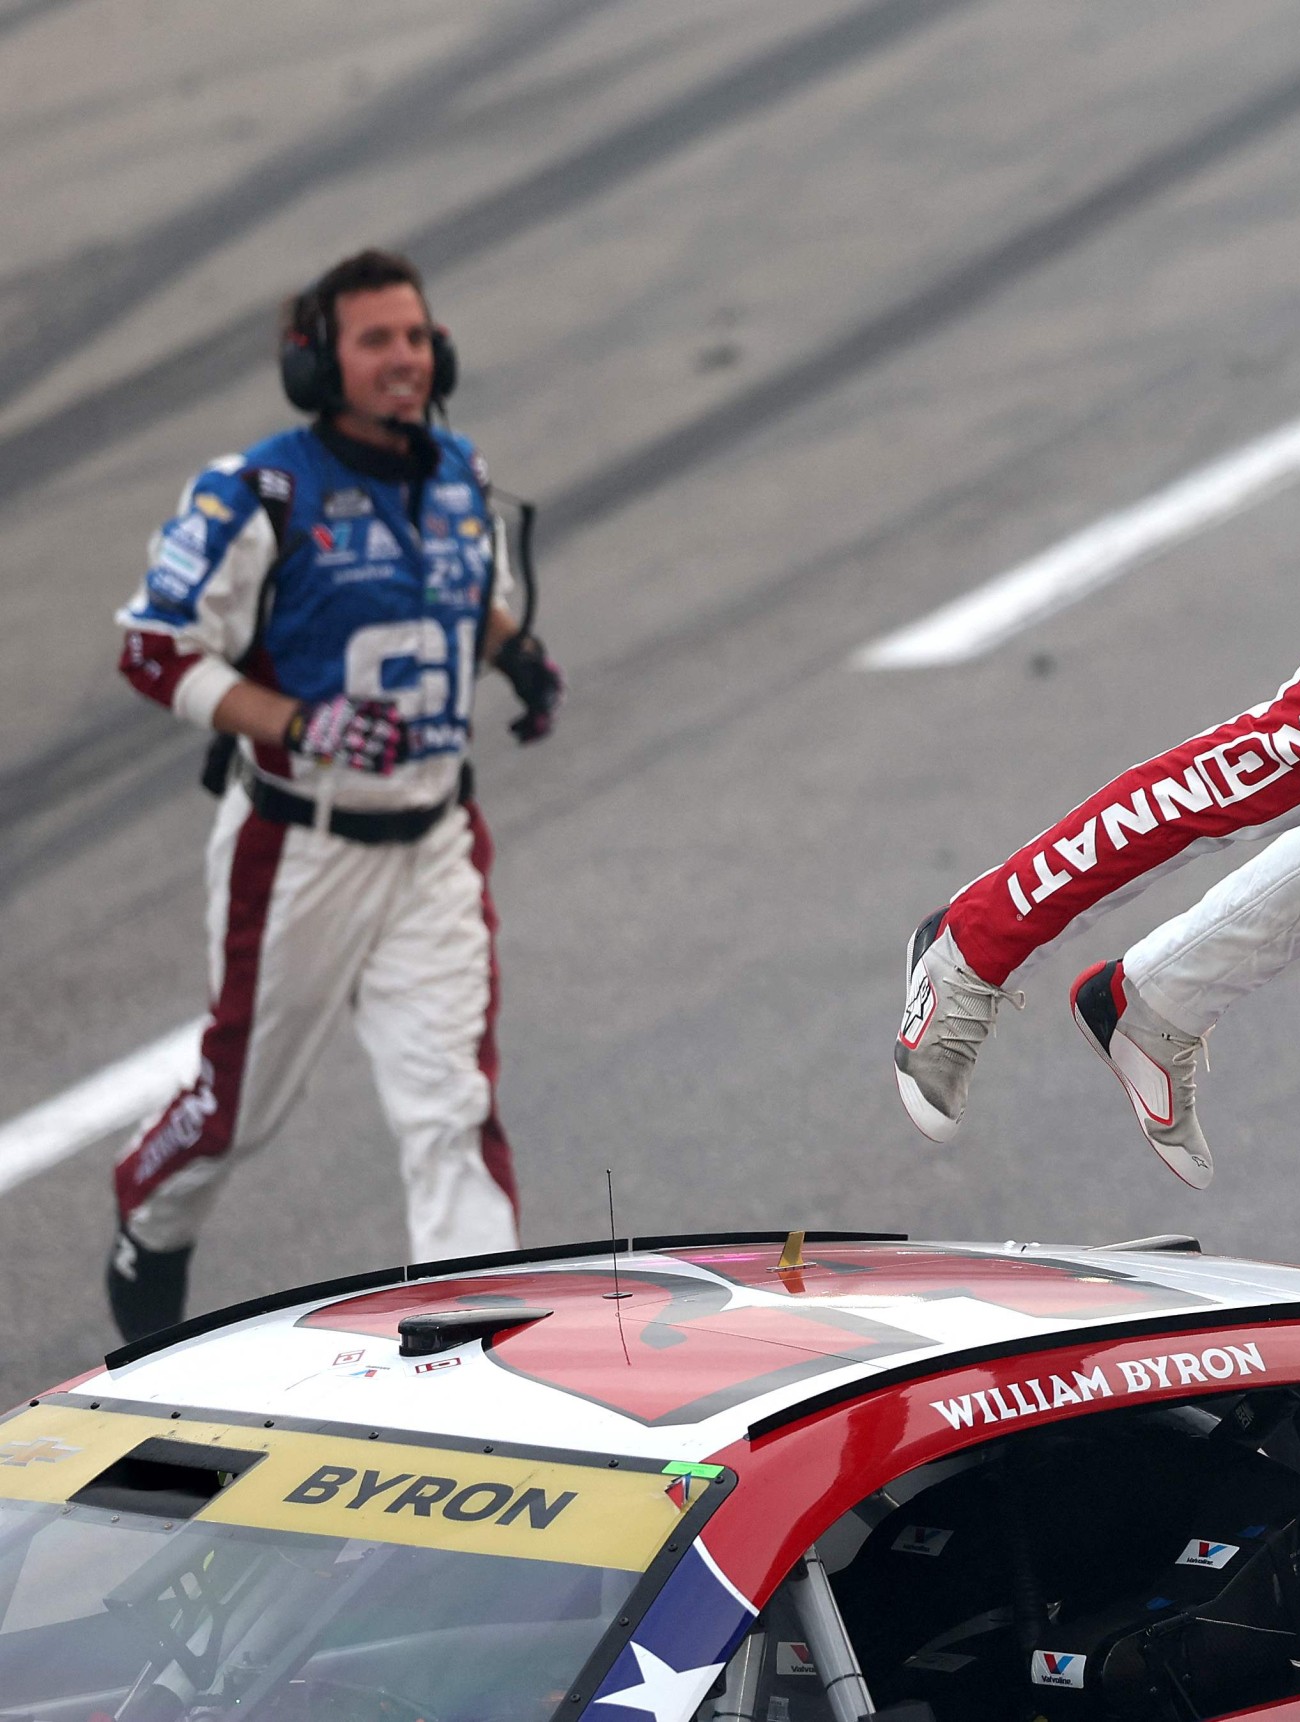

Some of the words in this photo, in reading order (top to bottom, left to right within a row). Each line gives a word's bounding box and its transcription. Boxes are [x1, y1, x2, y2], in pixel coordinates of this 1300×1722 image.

[346, 616, 476, 720] CI
[929, 1365, 1114, 1430] WILLIAM
[1116, 1343, 1267, 1394] BYRON
[285, 1464, 578, 1530] BYRON
[1041, 1674, 1073, 1686] Valvoline
